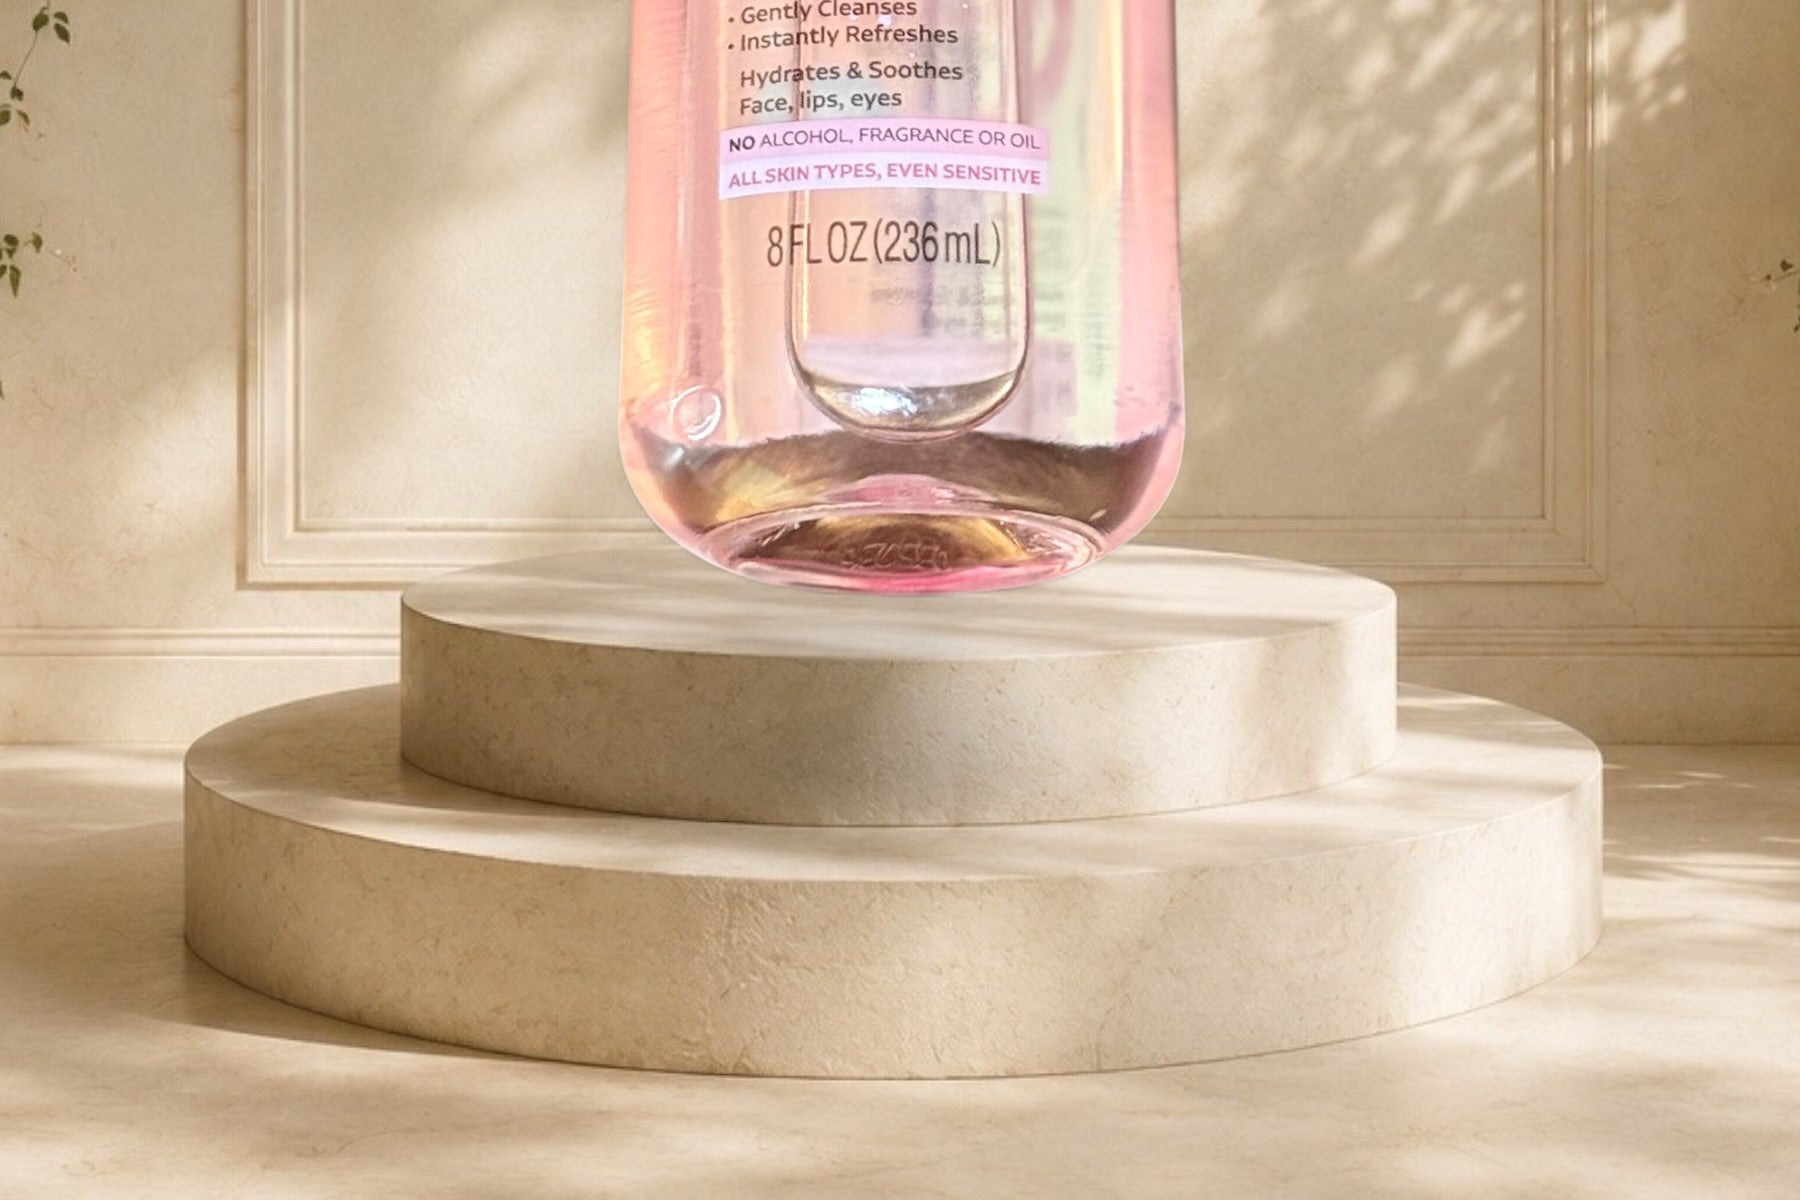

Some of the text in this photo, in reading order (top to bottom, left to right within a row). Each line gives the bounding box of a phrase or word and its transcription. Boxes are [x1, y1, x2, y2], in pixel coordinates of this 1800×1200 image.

[740, 1, 812, 24] Gently
[740, 24, 959, 51] Instantly Refreshes
[740, 61, 963, 89] Hydrates & Soothes
[740, 90, 902, 116] Face, lips, eyes
[728, 127, 1042, 152] NO ALCOHOL, FRAGRANCE OR OIL
[728, 163, 1042, 189] ALL SKIN TYPES, EVEN SENSITIVE
[766, 225, 784, 268] 8
[789, 222, 823, 266] FL
[827, 220, 868, 264] OZ
[945, 219, 1001, 268] mL)
